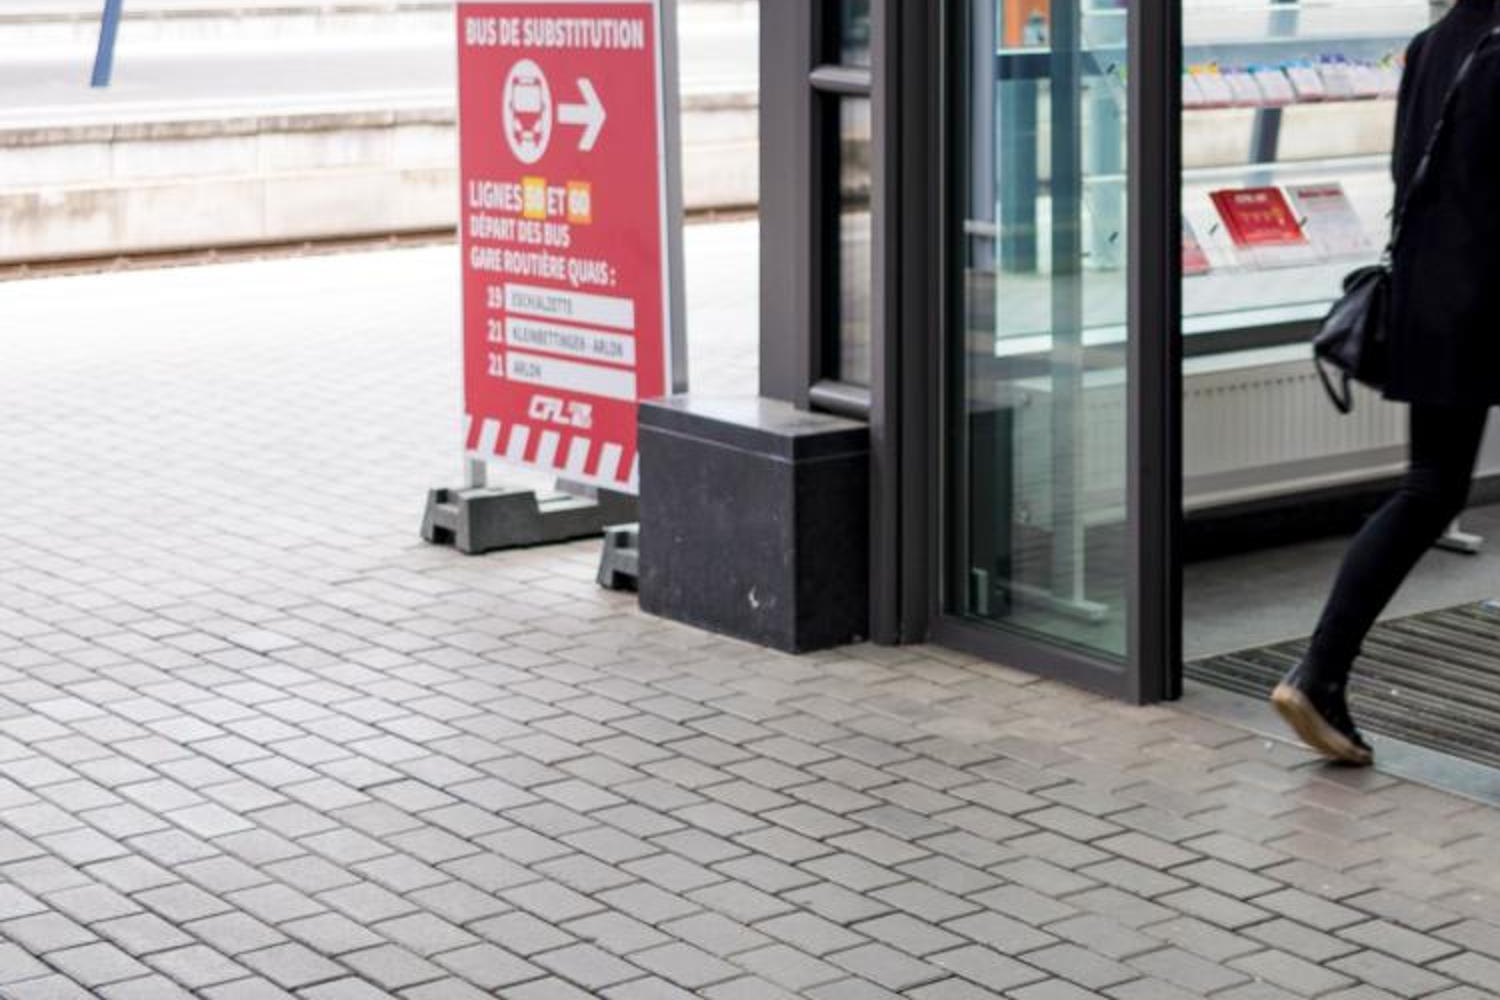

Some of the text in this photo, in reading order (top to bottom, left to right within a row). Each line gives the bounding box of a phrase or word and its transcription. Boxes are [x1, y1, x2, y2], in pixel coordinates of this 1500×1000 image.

[465, 17, 645, 49] BUS DE SUBSTITUTION
[470, 180, 522, 213] LIGNES
[547, 186, 566, 215] ET
[517, 218, 543, 243] DES
[545, 222, 570, 247] BUS
[471, 246, 503, 271] GARE
[568, 255, 608, 287] QUAIS
